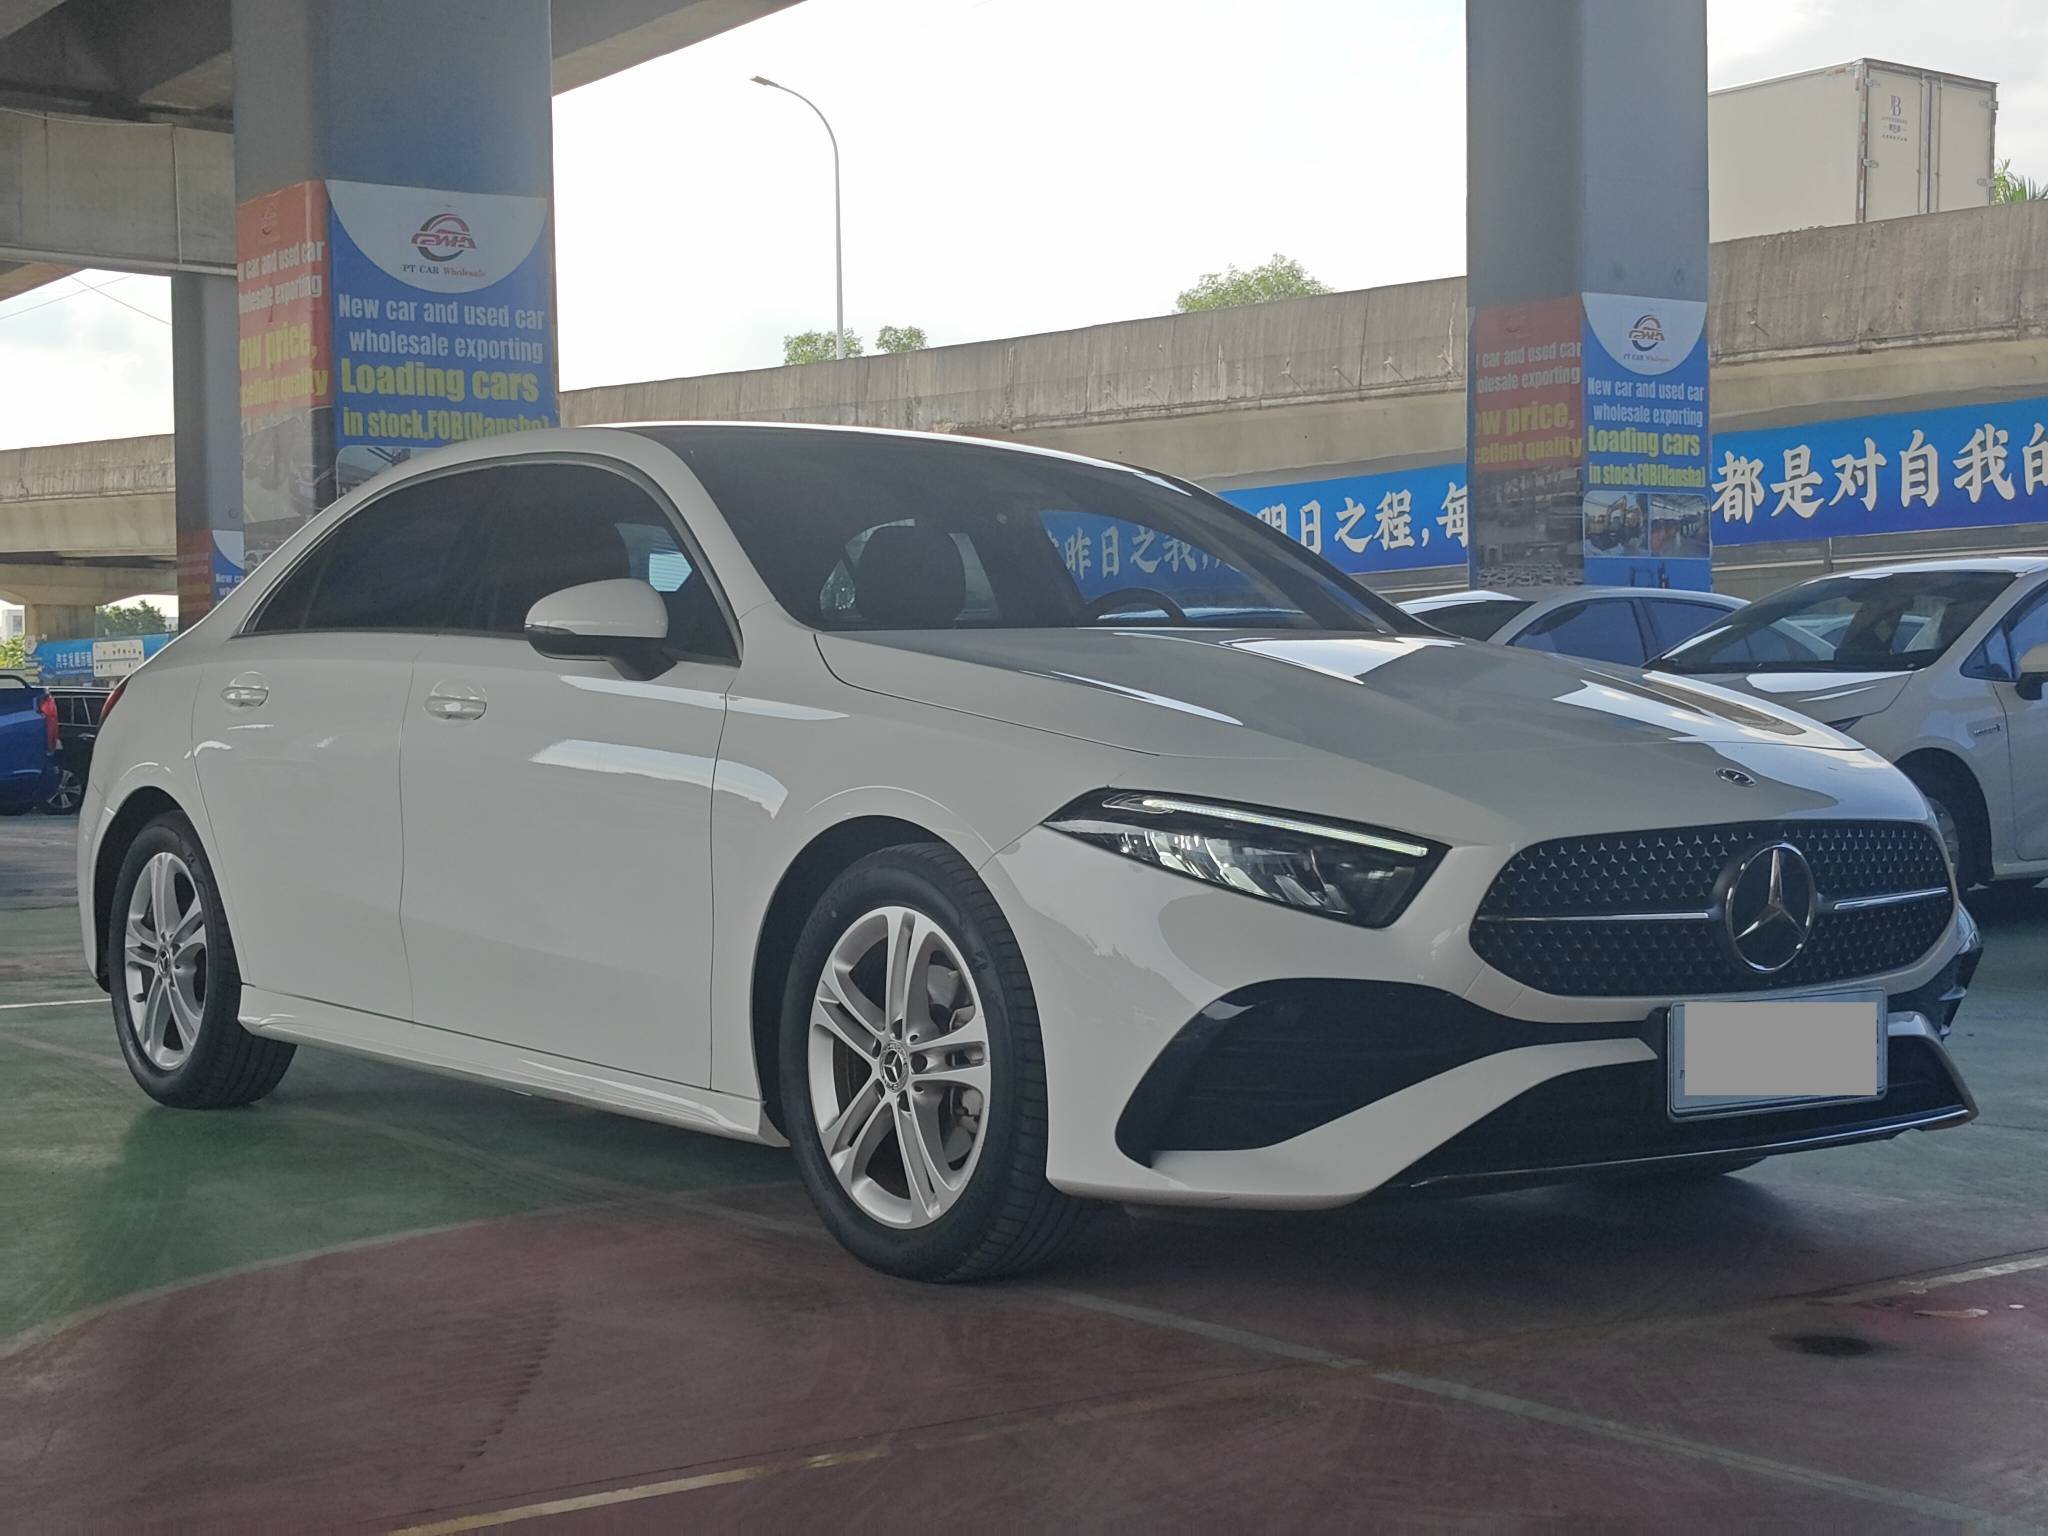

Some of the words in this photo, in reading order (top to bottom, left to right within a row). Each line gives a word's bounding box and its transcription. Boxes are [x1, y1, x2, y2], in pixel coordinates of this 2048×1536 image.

[301, 241, 325, 263] car
[419, 264, 440, 275] CAR
[274, 273, 323, 305] exporting
[339, 293, 379, 319] New
[386, 300, 418, 322] car
[423, 302, 458, 325] and
[464, 304, 509, 328] used
[515, 308, 545, 330] car
[265, 321, 320, 371] price,
[349, 329, 449, 357] wholesale
[455, 336, 544, 364] exporting
[1482, 352, 1501, 369] car
[1503, 347, 1525, 366] and
[1528, 341, 1557, 363] used
[1559, 342, 1582, 359] car
[341, 358, 465, 402] Loading
[472, 371, 540, 403] cars
[1521, 366, 1581, 389] exporting
[1587, 376, 1612, 396] New
[1614, 380, 1634, 397] car
[1635, 381, 1656, 399] and
[1658, 383, 1684, 401] used
[1687, 385, 1705, 402] car
[343, 407, 364, 437] in
[1504, 400, 1575, 437] price,
[1593, 403, 1651, 423] wholesale
[1652, 407, 1704, 429] exporting
[1525, 436, 1583, 461] quality
[1588, 424, 1659, 458] Loading
[1662, 433, 1701, 457] cars
[1588, 462, 1601, 484] in
